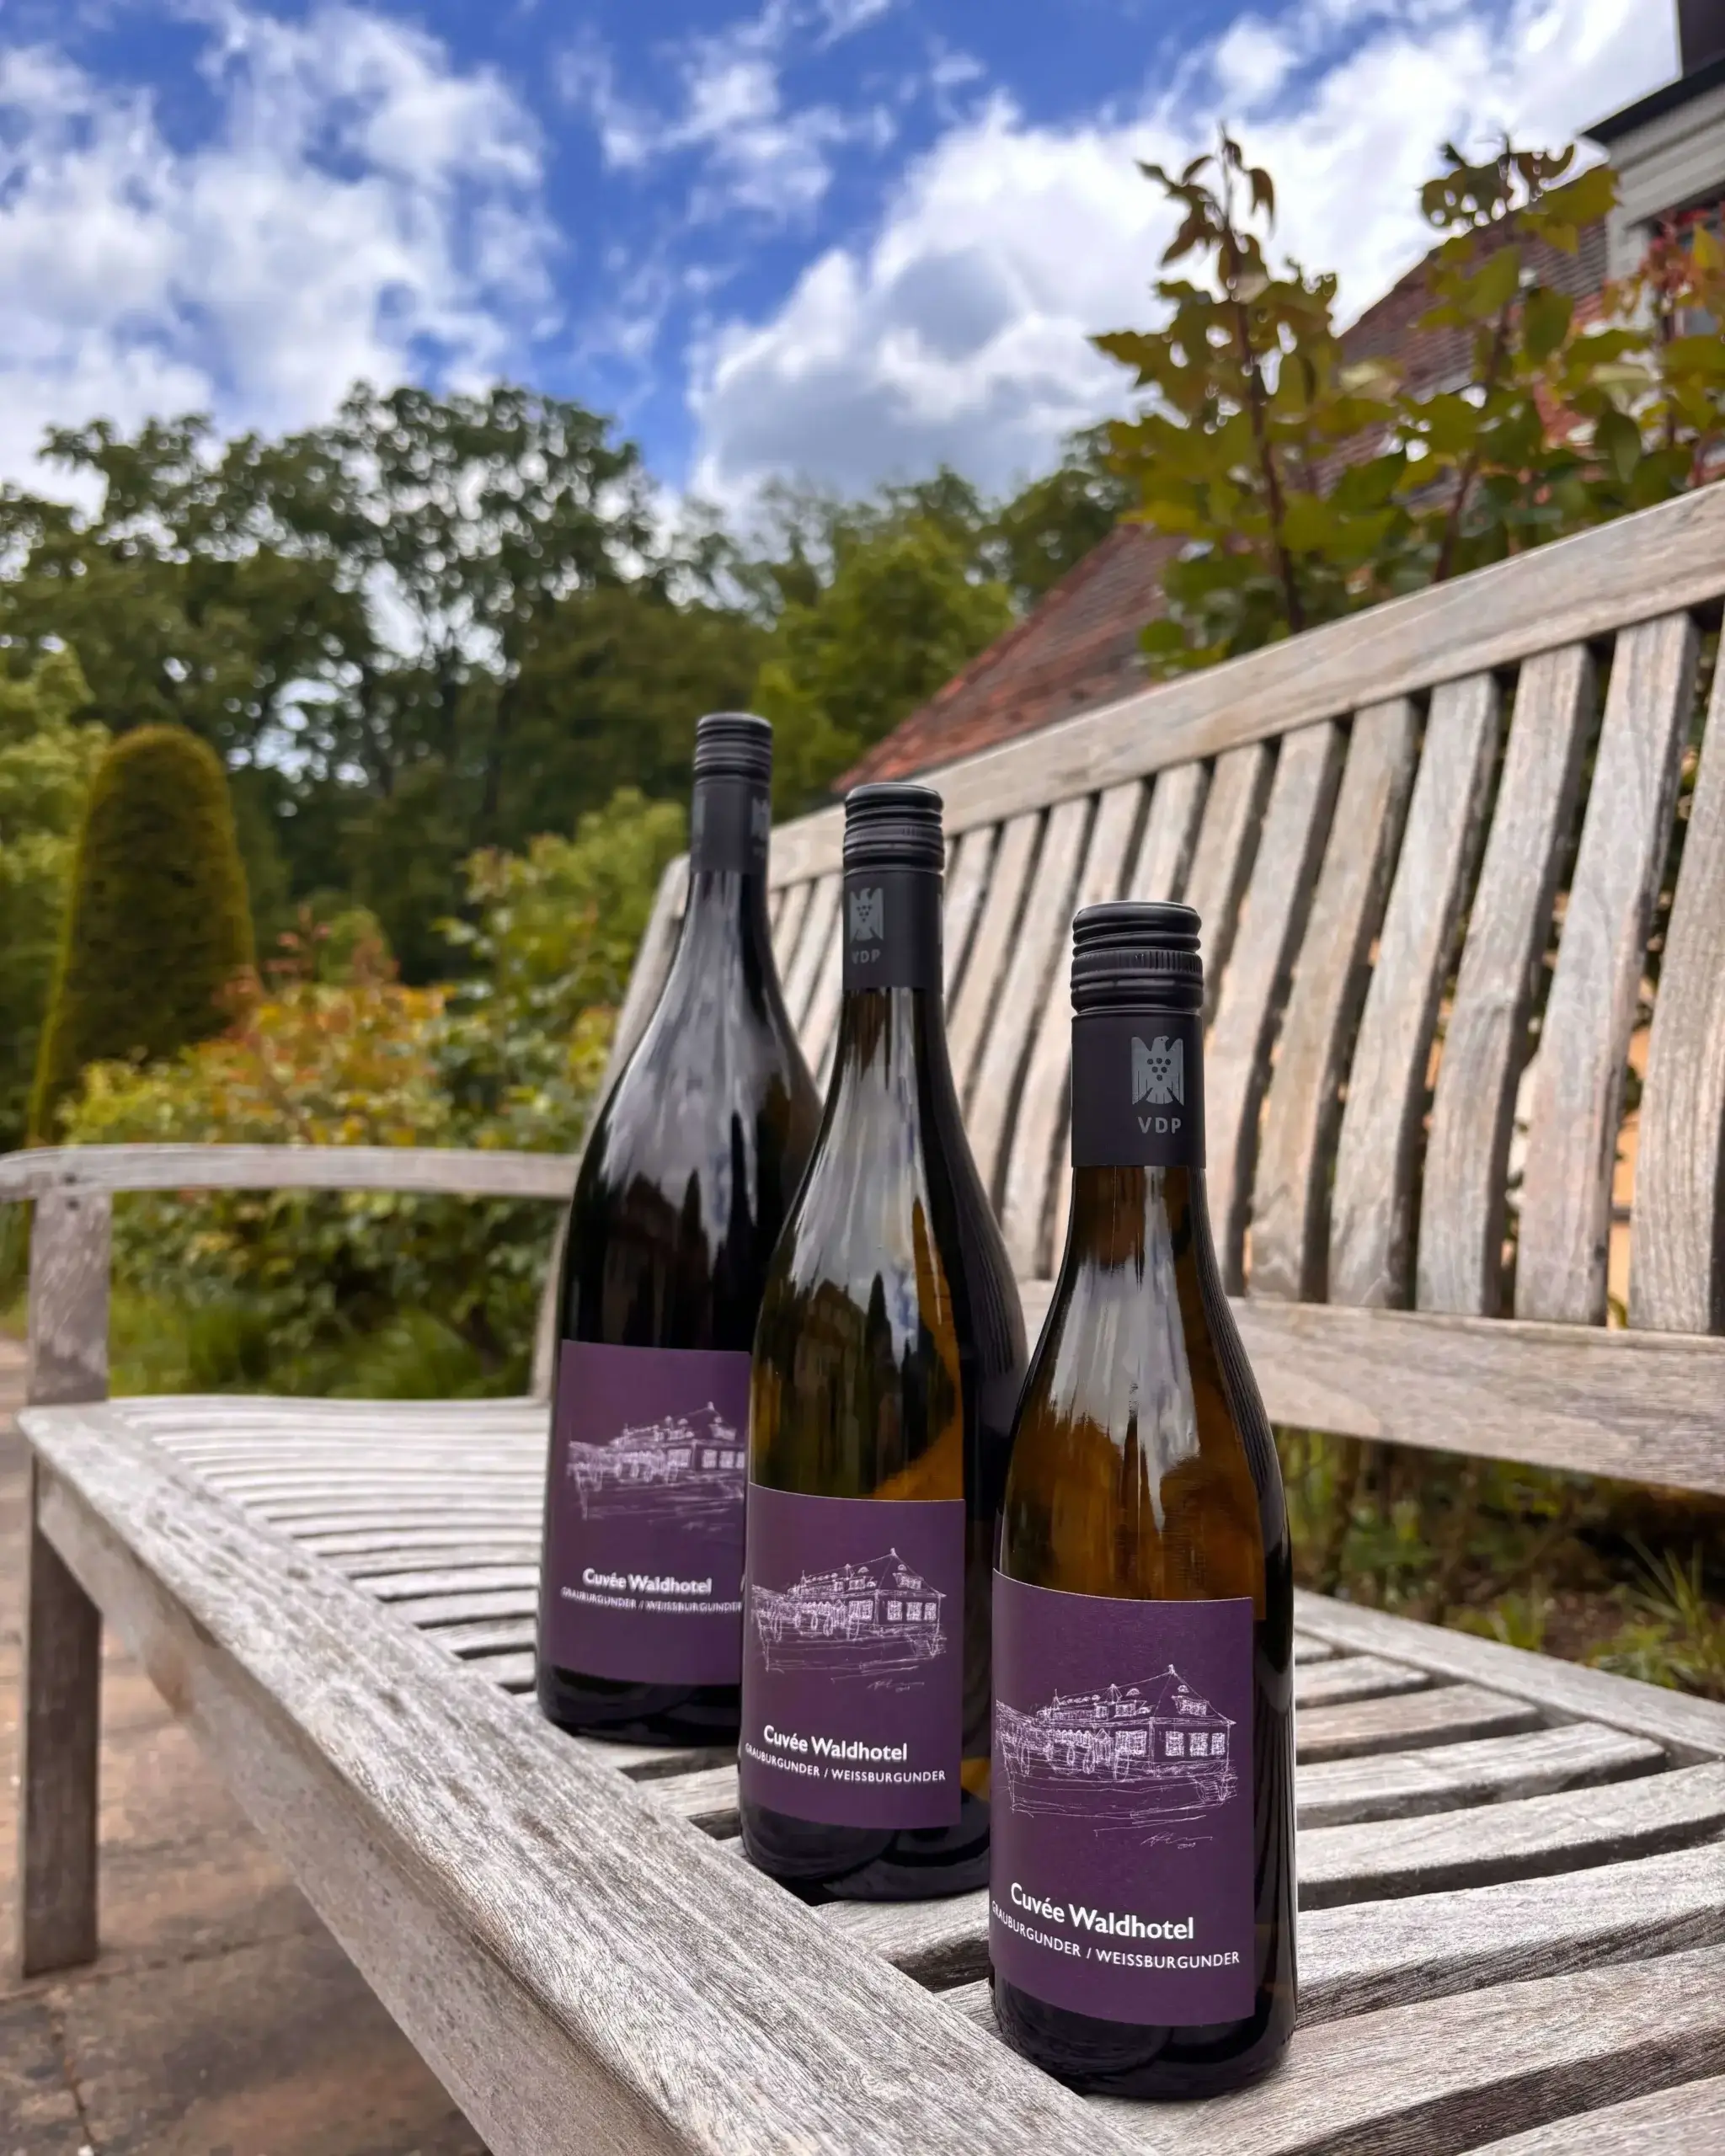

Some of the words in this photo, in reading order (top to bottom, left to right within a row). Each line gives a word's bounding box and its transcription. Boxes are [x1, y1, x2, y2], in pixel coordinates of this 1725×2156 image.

[851, 948, 881, 964] VDP
[1137, 1116, 1182, 1134] VDP
[582, 1567, 627, 1589] Cuvée
[628, 1573, 713, 1594] Waldhotel
[763, 1725, 809, 1753] Cuvée
[810, 1736, 908, 1761] Waldhotel
[745, 1742, 820, 1778] GRAUBURGUNDER
[824, 1768, 830, 1779] /
[830, 1769, 946, 1783] WEISSBURGUNDER
[1011, 1882, 1065, 1923] Cuvée
[1069, 1903, 1194, 1940] Waldhotel
[992, 1900, 1081, 1957] GRAUBURGUNDER
[1086, 1947, 1092, 1959] /
[1096, 1949, 1241, 1969] WEISSBURGUNDER
